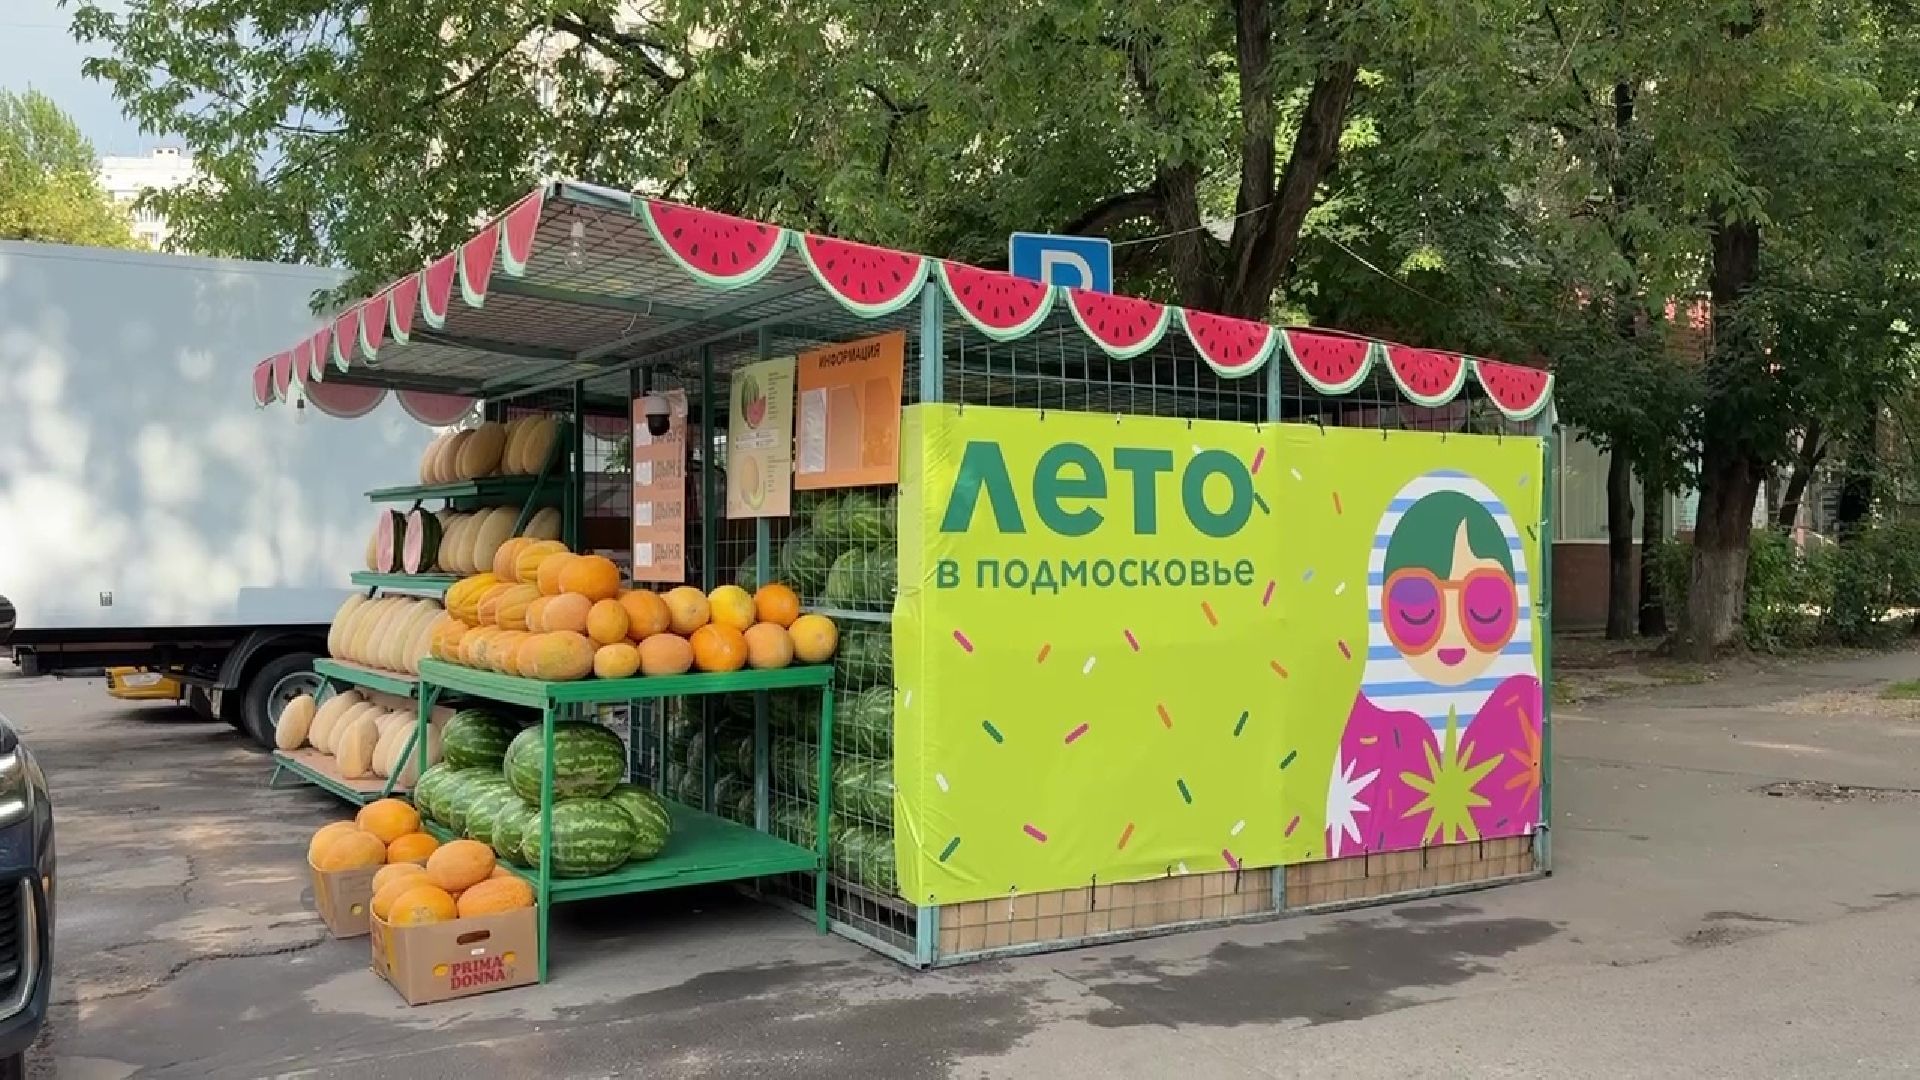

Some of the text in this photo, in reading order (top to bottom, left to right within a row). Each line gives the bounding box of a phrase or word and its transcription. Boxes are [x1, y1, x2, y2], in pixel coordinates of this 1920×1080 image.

[819, 342, 880, 368] ИНФОРМАЦИЯ
[655, 543, 682, 564] ДЫНЯ
[451, 956, 503, 976] PRIMA
[451, 969, 504, 990] DONNA
